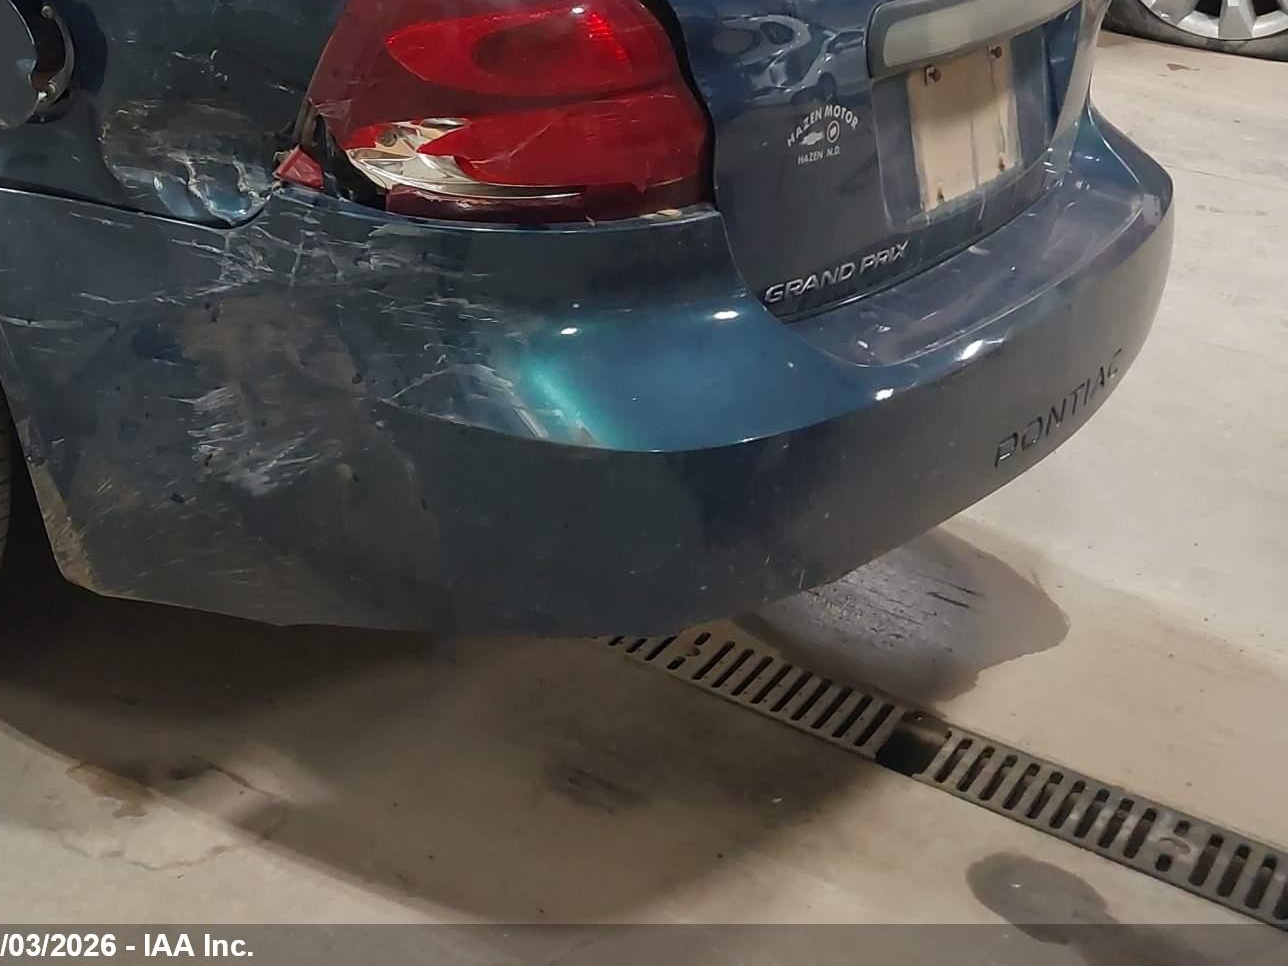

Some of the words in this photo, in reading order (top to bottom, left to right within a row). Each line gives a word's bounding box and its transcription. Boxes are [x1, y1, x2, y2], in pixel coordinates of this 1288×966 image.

[786, 107, 822, 147] HAZEN
[824, 103, 859, 130] MOTOR
[797, 149, 824, 166] HAZEN
[763, 262, 857, 304] GRAND
[859, 239, 910, 275] PRIX
[993, 346, 1123, 469] PONTIAC
